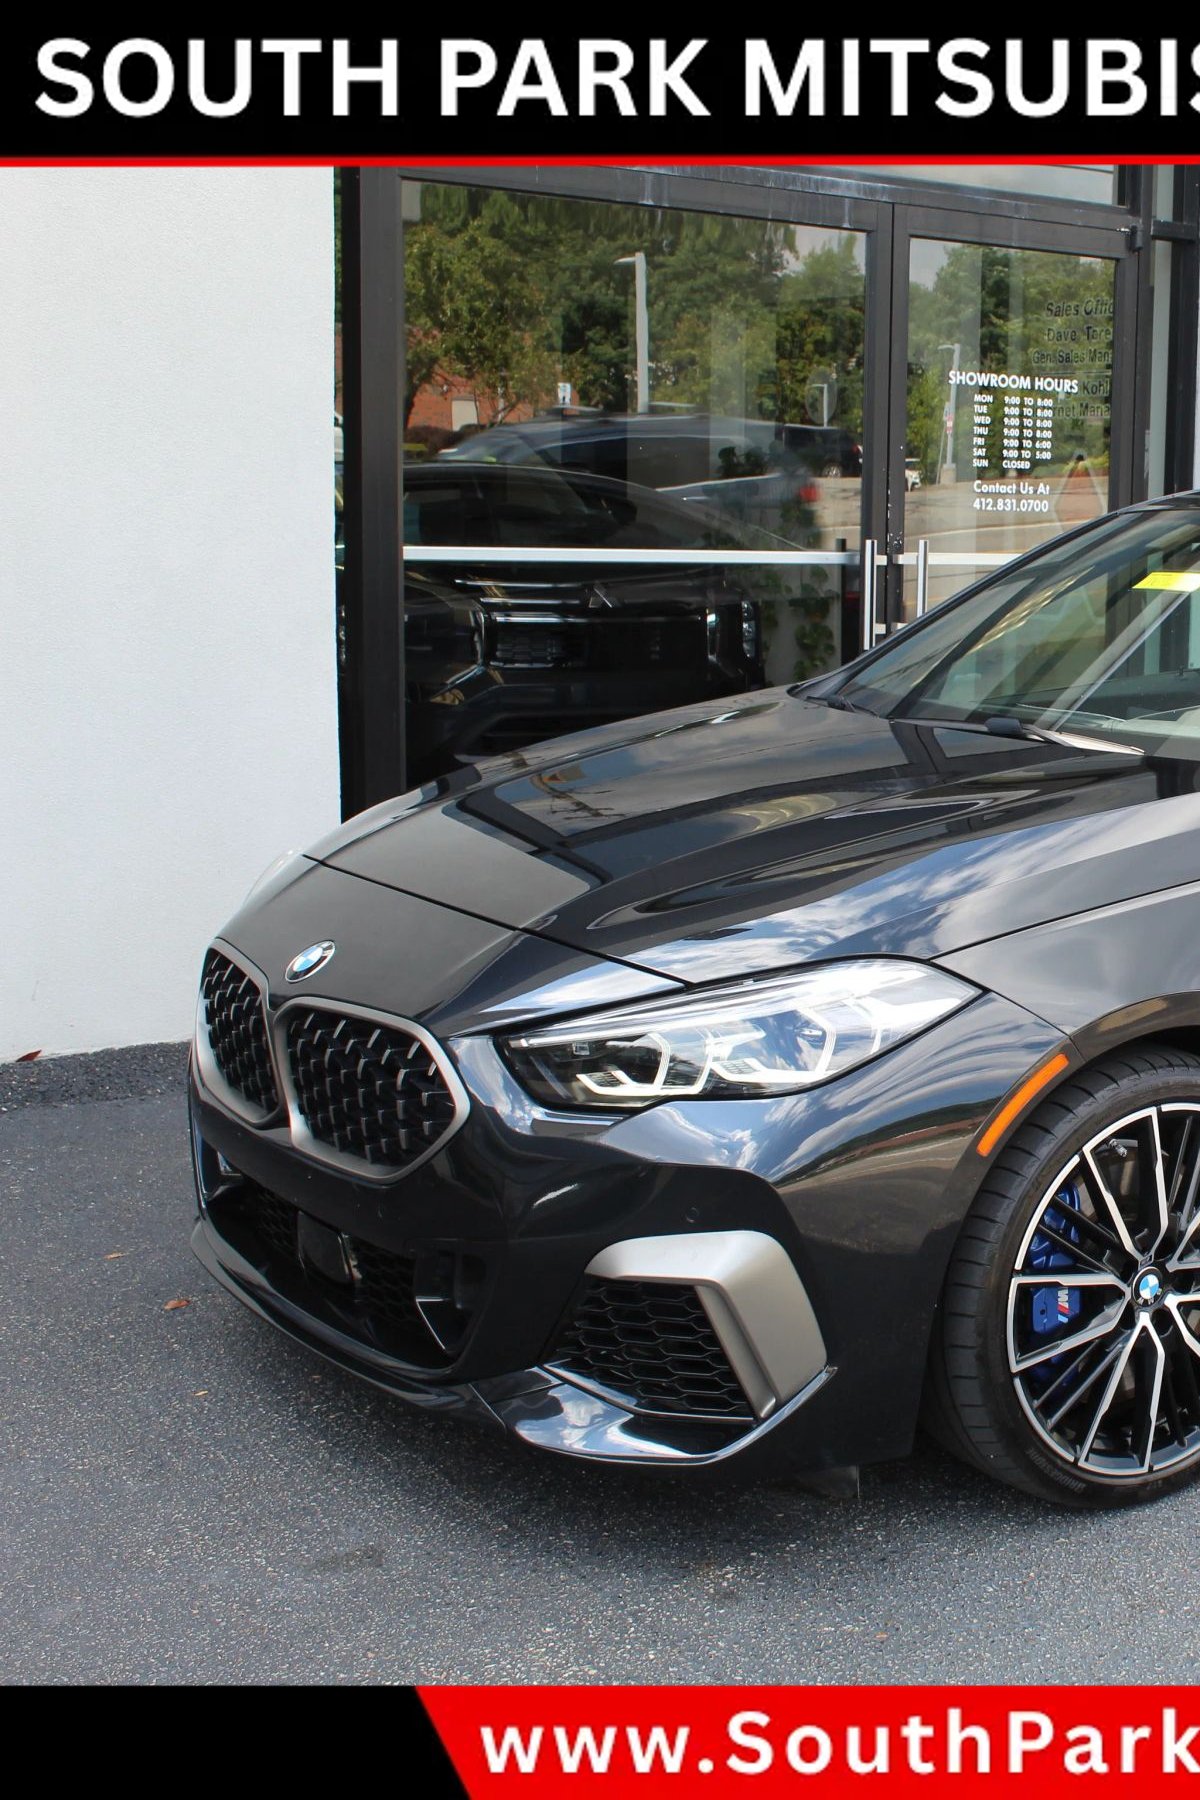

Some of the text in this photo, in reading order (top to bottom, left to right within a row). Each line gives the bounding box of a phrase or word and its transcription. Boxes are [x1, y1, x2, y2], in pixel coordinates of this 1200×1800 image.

[1046, 302, 1080, 318] Sales
[948, 370, 1079, 393] SHOWROOM HOURS
[974, 394, 993, 403] MON
[1004, 396, 1020, 405] 9:00
[1024, 397, 1034, 405] TO
[974, 405, 987, 413] TUE
[1004, 406, 1020, 416] 9:00
[1023, 407, 1033, 416] TO
[974, 416, 991, 425] WED
[1003, 417, 1020, 426] 9:00
[1023, 418, 1033, 427] TO
[974, 426, 988, 435] THU
[1003, 428, 1020, 437] 9:00
[1023, 429, 1033, 438] TO
[973, 437, 985, 446] FRI
[1003, 438, 1019, 448] 9:00
[1022, 439, 1033, 448] TO
[973, 448, 986, 457] SAT
[1002, 449, 1019, 458] 9:00
[1021, 450, 1031, 459] TO
[973, 459, 1031, 469] SUN CLOSED
[973, 480, 1050, 495] Contact Us At
[973, 498, 1049, 512] 412.831.0700
